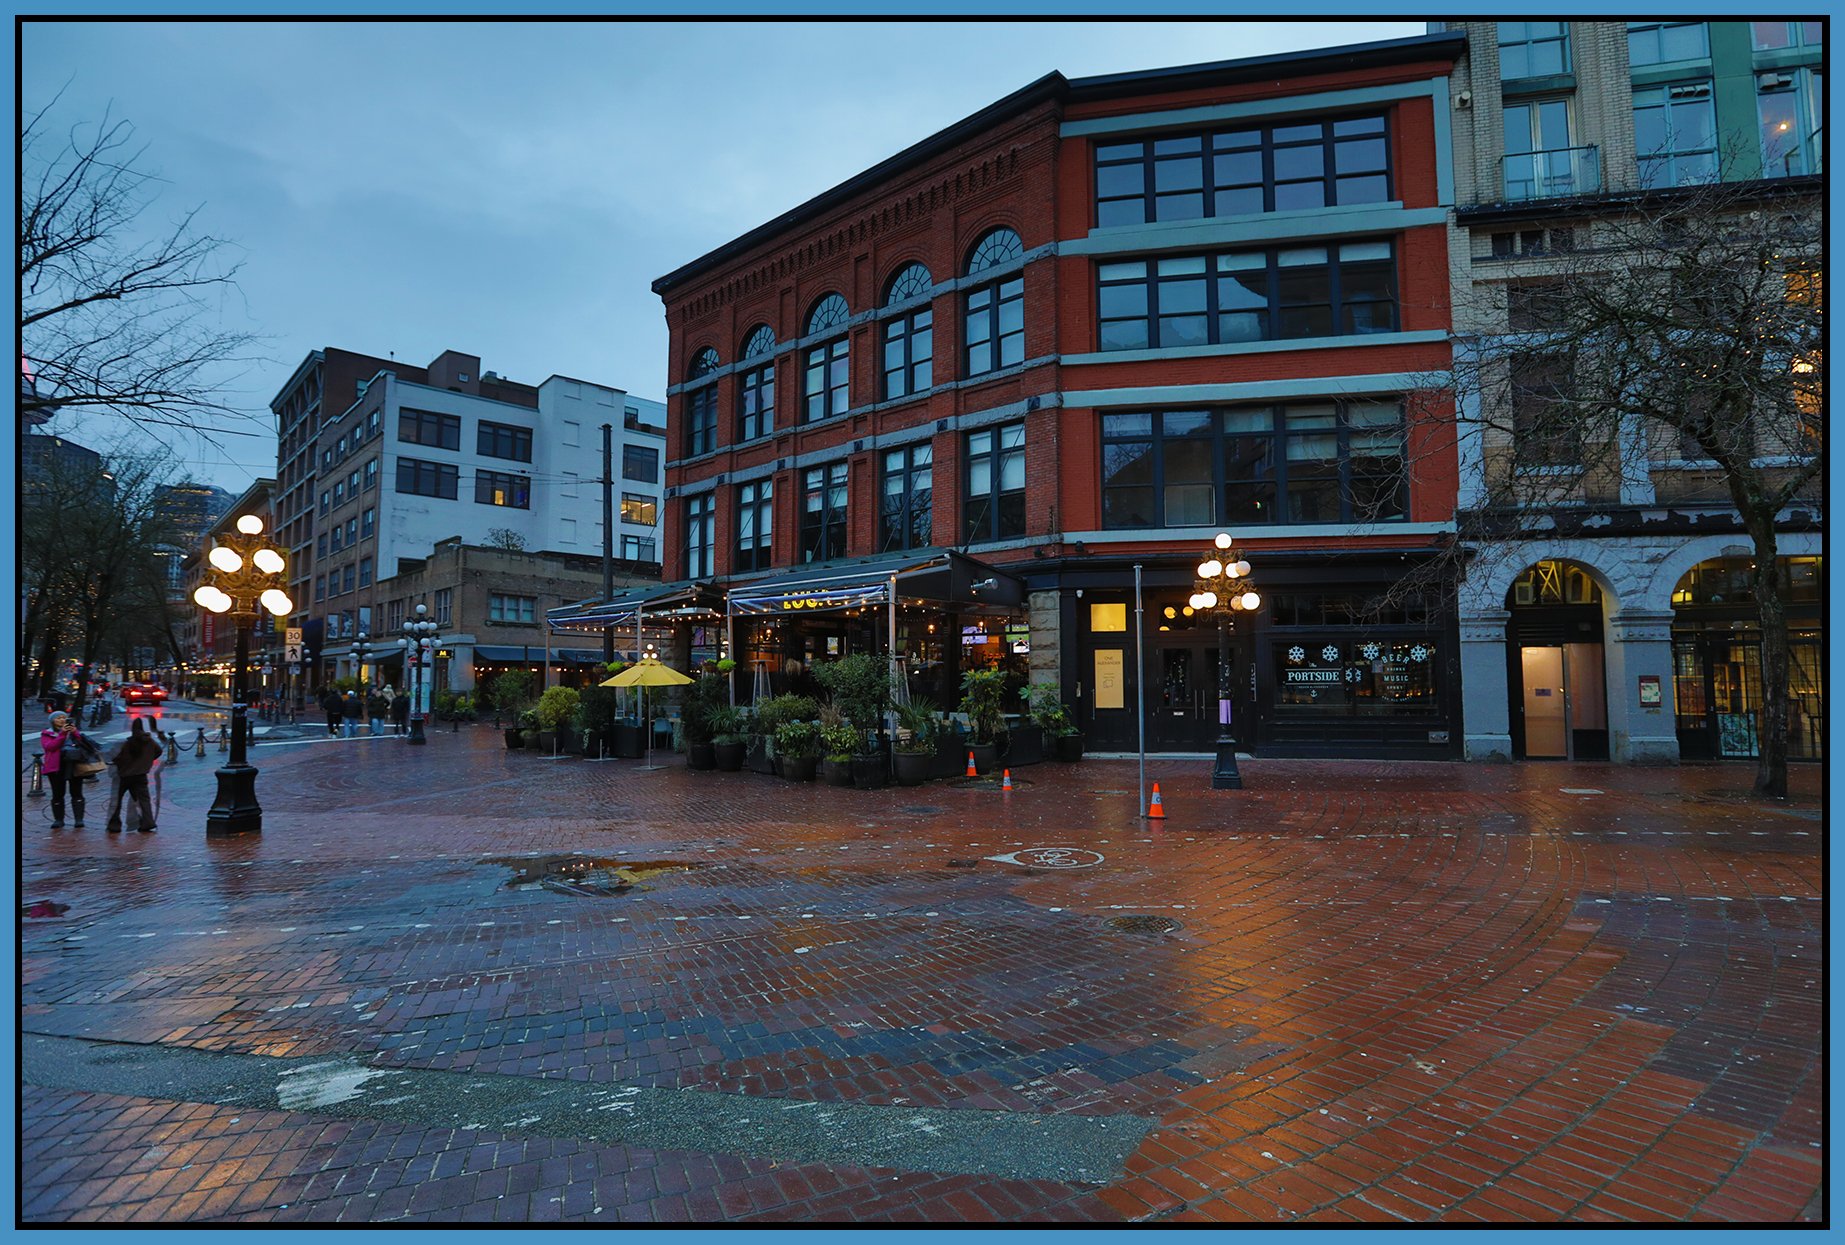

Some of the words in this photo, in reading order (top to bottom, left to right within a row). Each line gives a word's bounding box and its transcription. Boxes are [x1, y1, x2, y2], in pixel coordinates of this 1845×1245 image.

[288, 632, 301, 640] 30
[1381, 653, 1410, 664] BEER
[1287, 671, 1340, 681] PORTSIDE
